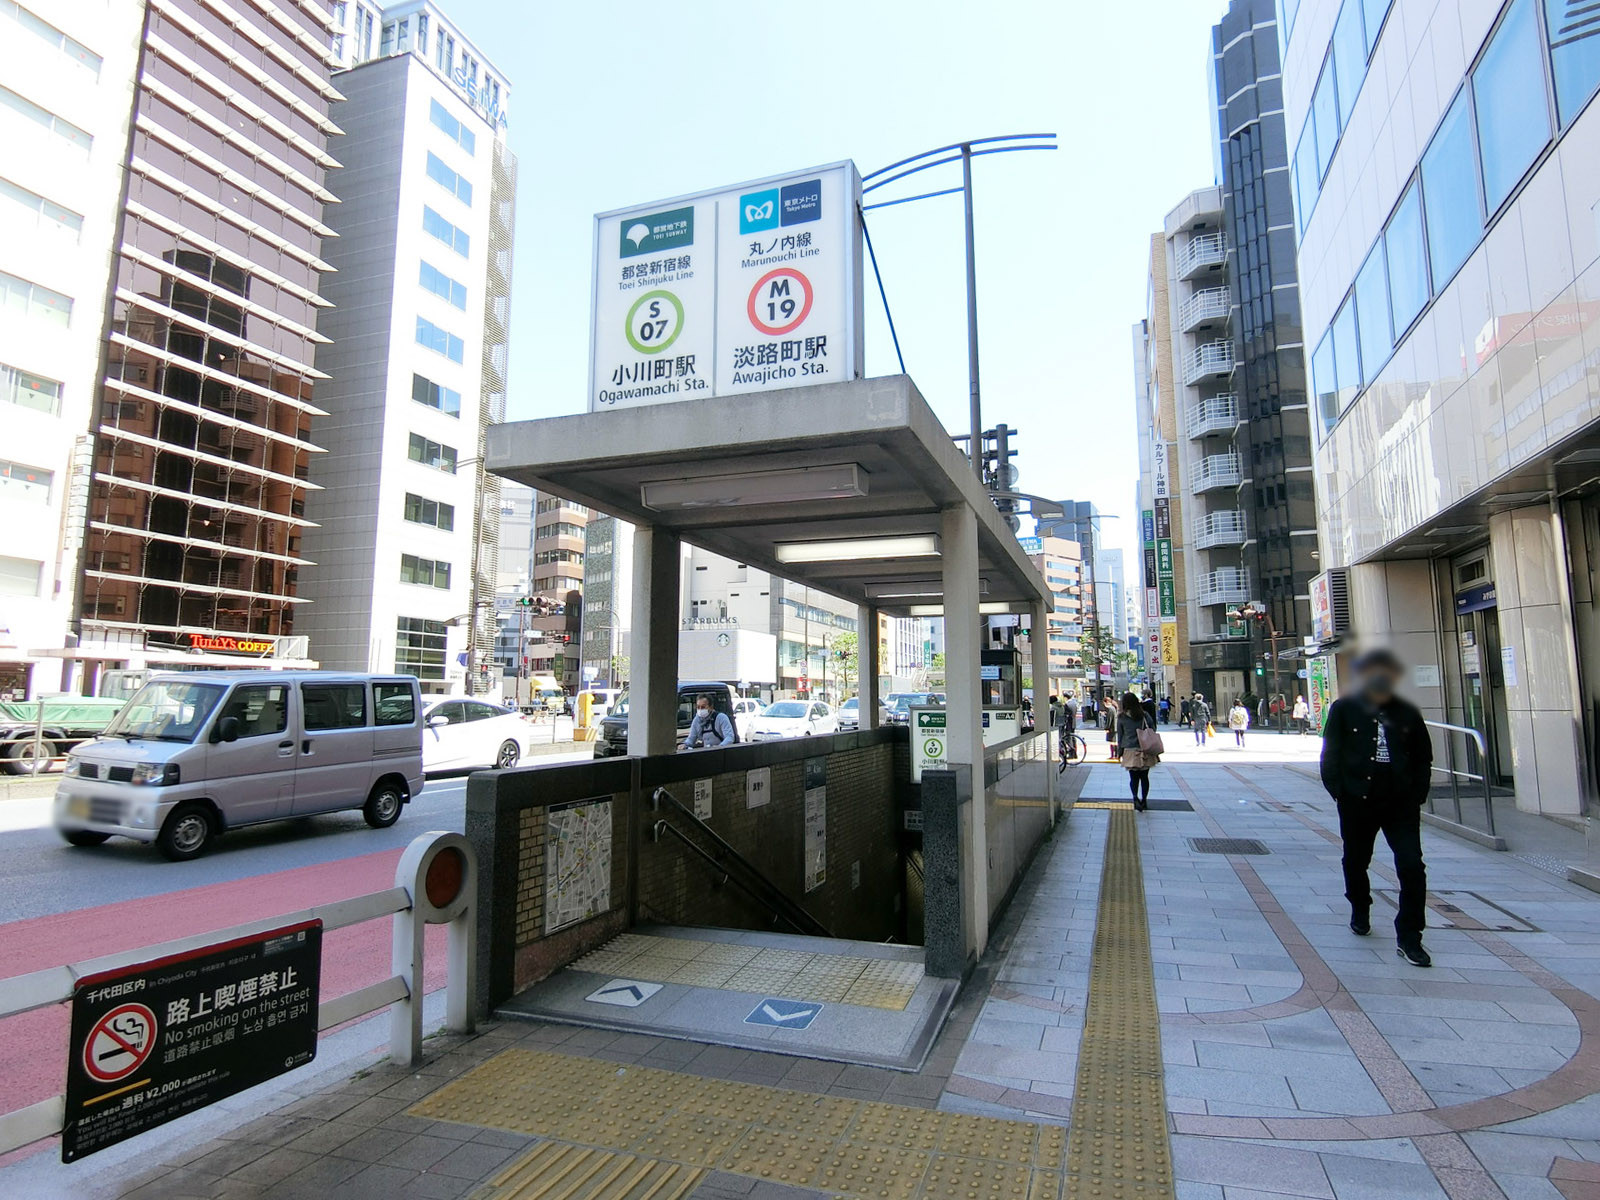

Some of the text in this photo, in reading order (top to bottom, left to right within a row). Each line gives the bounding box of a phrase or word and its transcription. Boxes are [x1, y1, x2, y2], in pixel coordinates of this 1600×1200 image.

[454, 67, 508, 128] SEIWA
[783, 193, 818, 208] 東京メトロ
[653, 221, 687, 234] 都営地下鉄
[666, 229, 687, 239] SUBWAY
[749, 232, 812, 256] 丸ノ内線
[621, 255, 691, 280] 都営新宿線
[741, 246, 820, 268] Marunouchi Line
[618, 270, 694, 291] Toei Shinjuku Line
[770, 279, 790, 298] M
[650, 301, 660, 318] S
[768, 299, 796, 321] 19
[640, 320, 668, 341] 07
[733, 335, 827, 369] 淡路町駅
[612, 354, 696, 385] 小川町駅
[732, 362, 829, 385] Awajicho Sta.
[599, 376, 709, 404] Ogawamachi Sta.
[1155, 442, 1166, 495] カルフール神田
[682, 617, 737, 625] STARBUCKS
[157, 972, 184, 986] Chiyoda
[185, 969, 197, 978] City
[87, 978, 146, 1004] 千代田区内
[166, 966, 298, 1027] 路上喫煙禁止
[165, 987, 310, 1046] No smoking on the street
[242, 1018, 264, 1035] 노상
[289, 1002, 309, 1020] 금지
[163, 1028, 236, 1064] 道路禁止吸烟
[146, 1079, 180, 1099] ¥2,000
[78, 1124, 92, 1134] You
